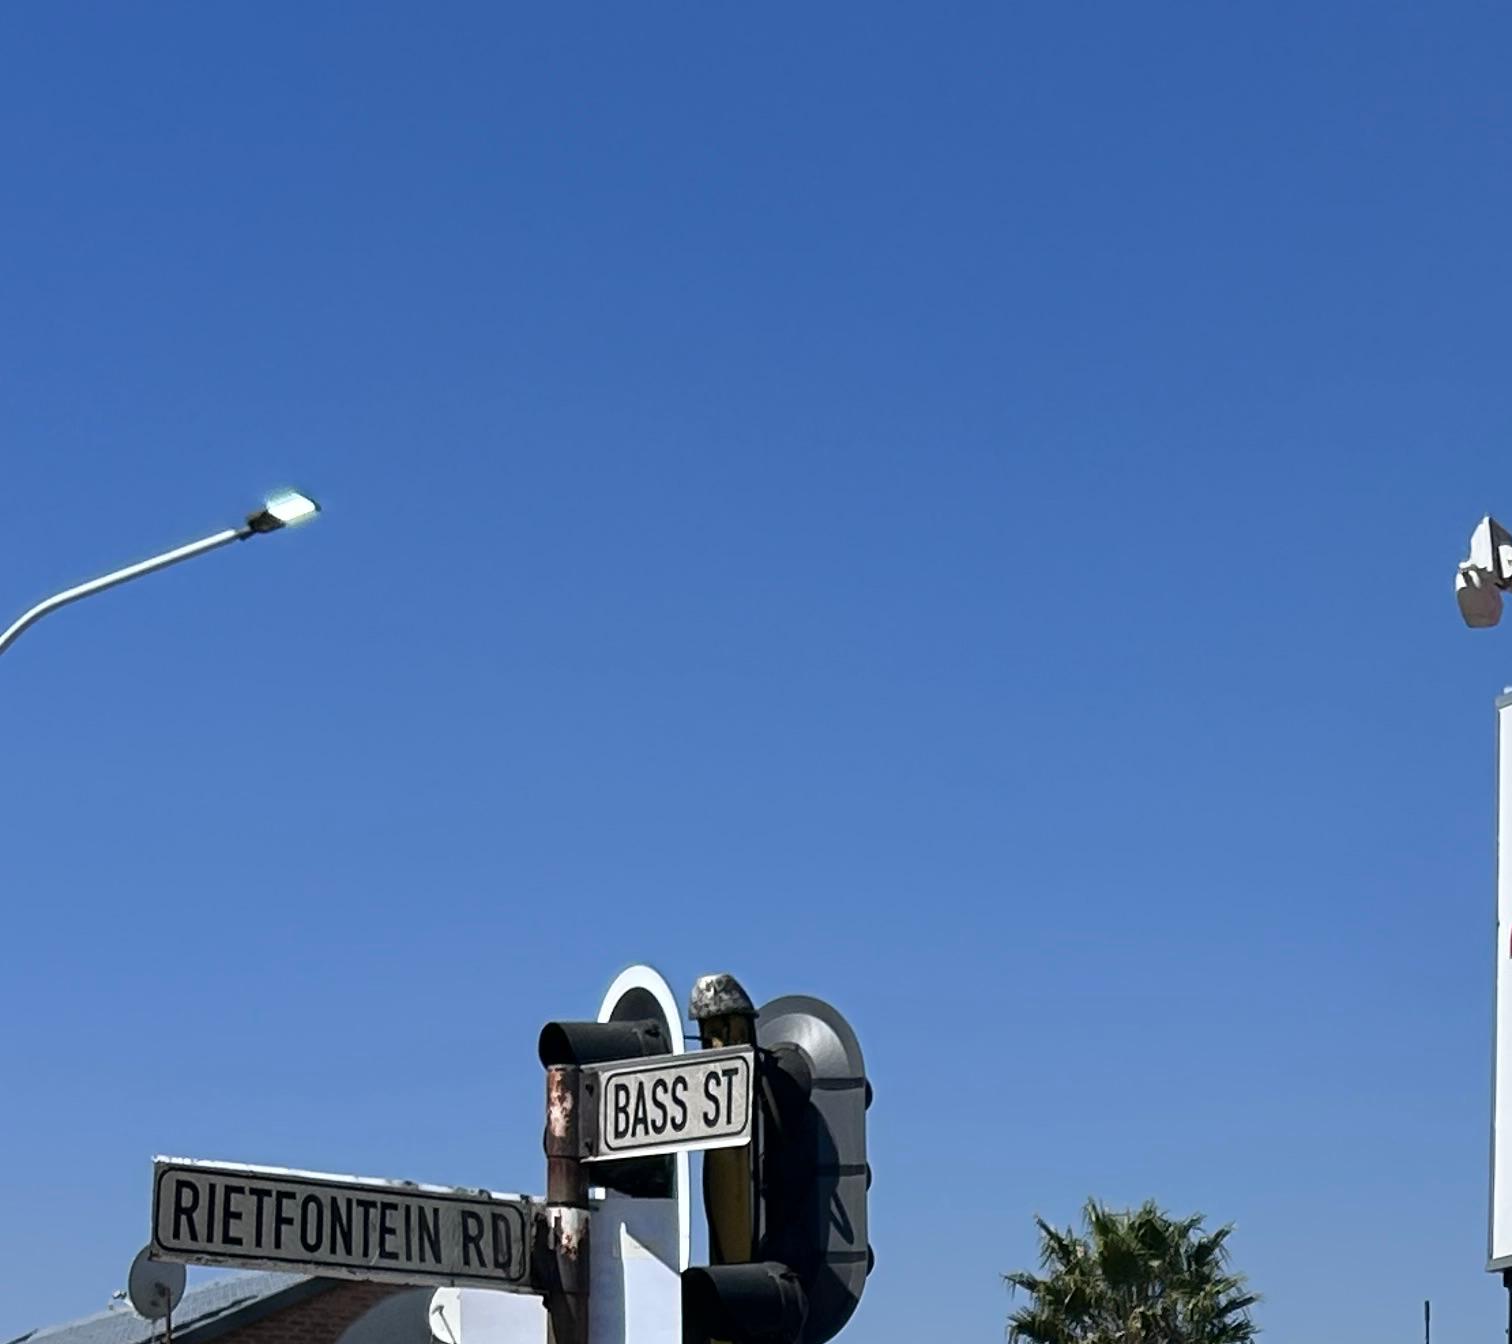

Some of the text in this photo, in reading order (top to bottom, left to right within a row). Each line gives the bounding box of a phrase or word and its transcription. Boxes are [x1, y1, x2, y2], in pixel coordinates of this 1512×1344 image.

[613, 1067, 740, 1140] BASS ST
[172, 1178, 513, 1271] RIETFONTEIN RD
